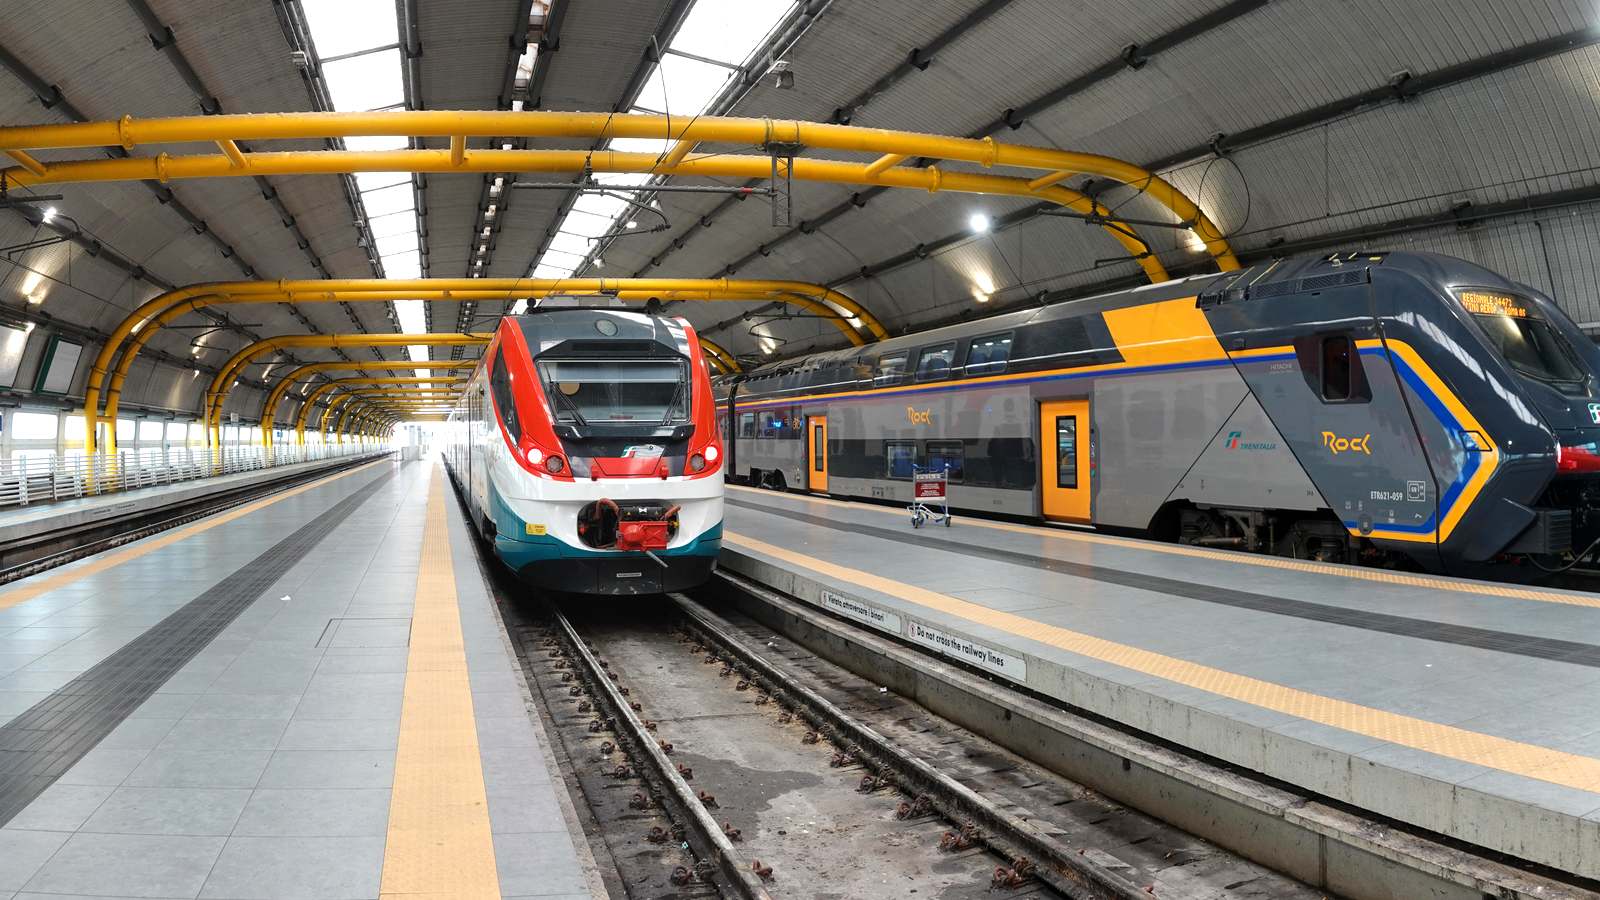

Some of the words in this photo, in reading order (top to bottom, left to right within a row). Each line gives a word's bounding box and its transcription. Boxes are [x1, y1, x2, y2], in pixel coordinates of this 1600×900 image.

[1462, 292, 1493, 305] REGIONALE
[1370, 490, 1403, 501] ETR621-059
[828, 593, 843, 608] Vietato
[842, 601, 868, 616] attraversare
[870, 607, 885, 621] binari
[917, 626, 925, 638] Do
[925, 631, 936, 641] not
[936, 635, 951, 647] cross
[950, 638, 961, 651] the
[962, 643, 987, 662] railway
[987, 650, 1005, 666] lines
